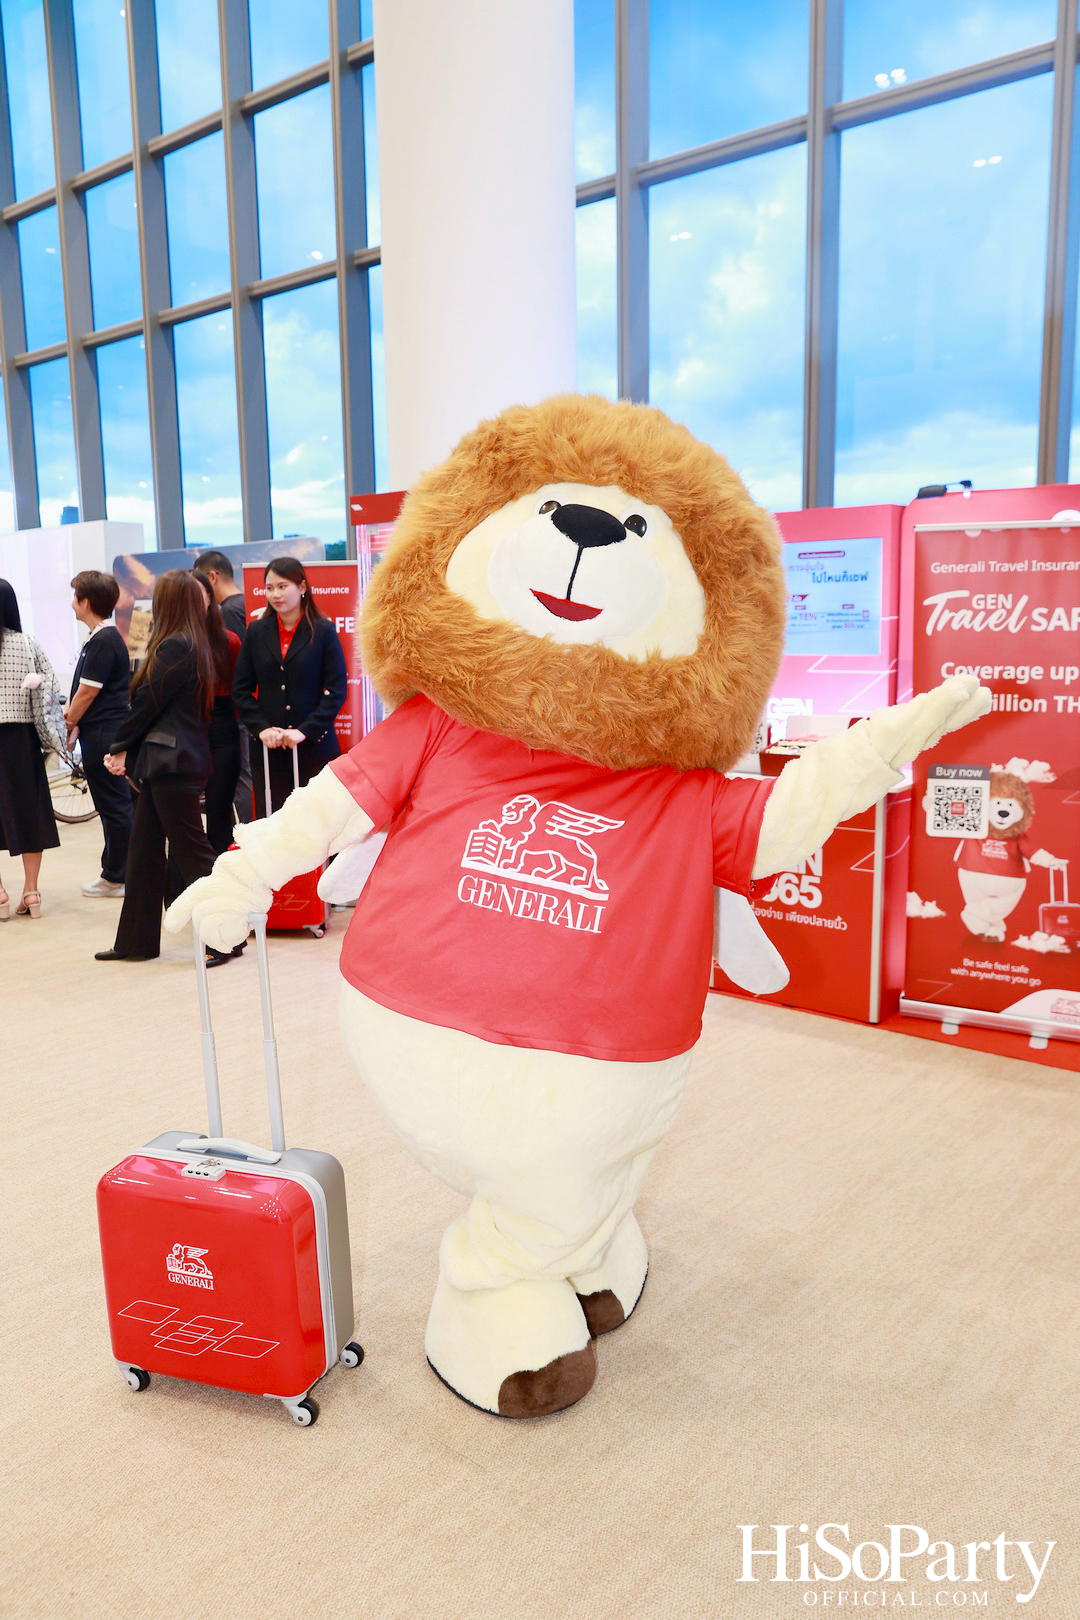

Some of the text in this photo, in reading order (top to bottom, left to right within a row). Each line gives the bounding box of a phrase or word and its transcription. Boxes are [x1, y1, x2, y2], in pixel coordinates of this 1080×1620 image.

[930, 561, 985, 574] Generali
[988, 560, 1028, 573] Travel
[311, 586, 350, 595] Insurance
[971, 593, 1013, 610] GEN
[922, 589, 1029, 636] Travel
[1049, 665, 1080, 685] up
[989, 693, 1048, 713] illion
[935, 766, 984, 779] Buy now
[457, 874, 606, 934] GENERALI
[963, 958, 1030, 975] Be safe feel safe
[950, 967, 1042, 987] with anywhere you go
[168, 1272, 215, 1291] GENERALI
